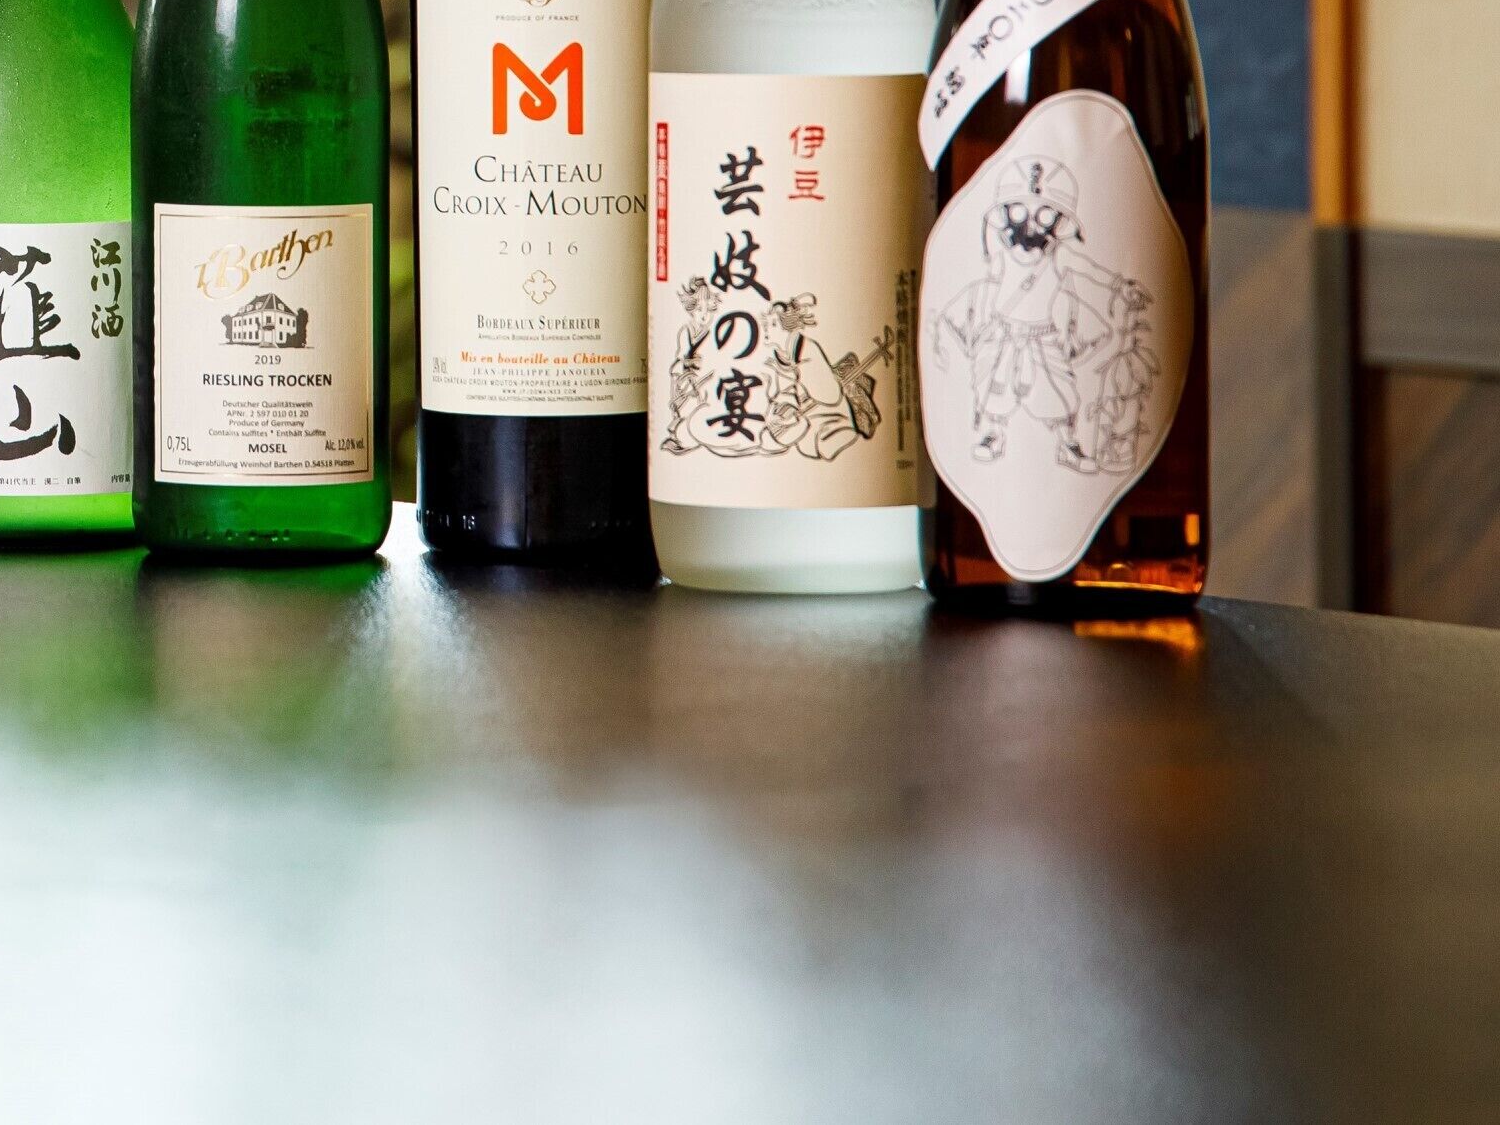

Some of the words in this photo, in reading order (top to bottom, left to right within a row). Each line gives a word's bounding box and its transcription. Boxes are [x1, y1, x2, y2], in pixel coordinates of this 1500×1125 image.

[493, 42, 583, 135] M
[474, 155, 603, 183] CHÂTEAU
[788, 125, 825, 202] 伊豆
[434, 186, 506, 216] CROIX
[526, 189, 648, 217] MOUTON
[499, 241, 579, 255] 2016
[90, 237, 124, 339] 江川酒
[707, 146, 771, 442] 芸妓の宴
[477, 314, 534, 330] BORDEAUX
[539, 315, 600, 330] SUPÉRIEUR
[254, 354, 281, 365] 2019
[461, 350, 477, 363] Mis
[498, 352, 548, 364] bouteille
[554, 356, 568, 364] au
[573, 352, 621, 364] Château
[203, 373, 264, 387] RIESLING
[270, 374, 332, 387] TROCKEN
[222, 400, 258, 408] Deutscher
[261, 400, 313, 408] Qualitätswein
[229, 419, 259, 427] Produce
[271, 420, 305, 428] Germany
[241, 429, 268, 437] sulfites
[167, 435, 191, 452] 0,75L
[248, 444, 287, 453] MOSEL
[111, 474, 131, 484] 内容量
